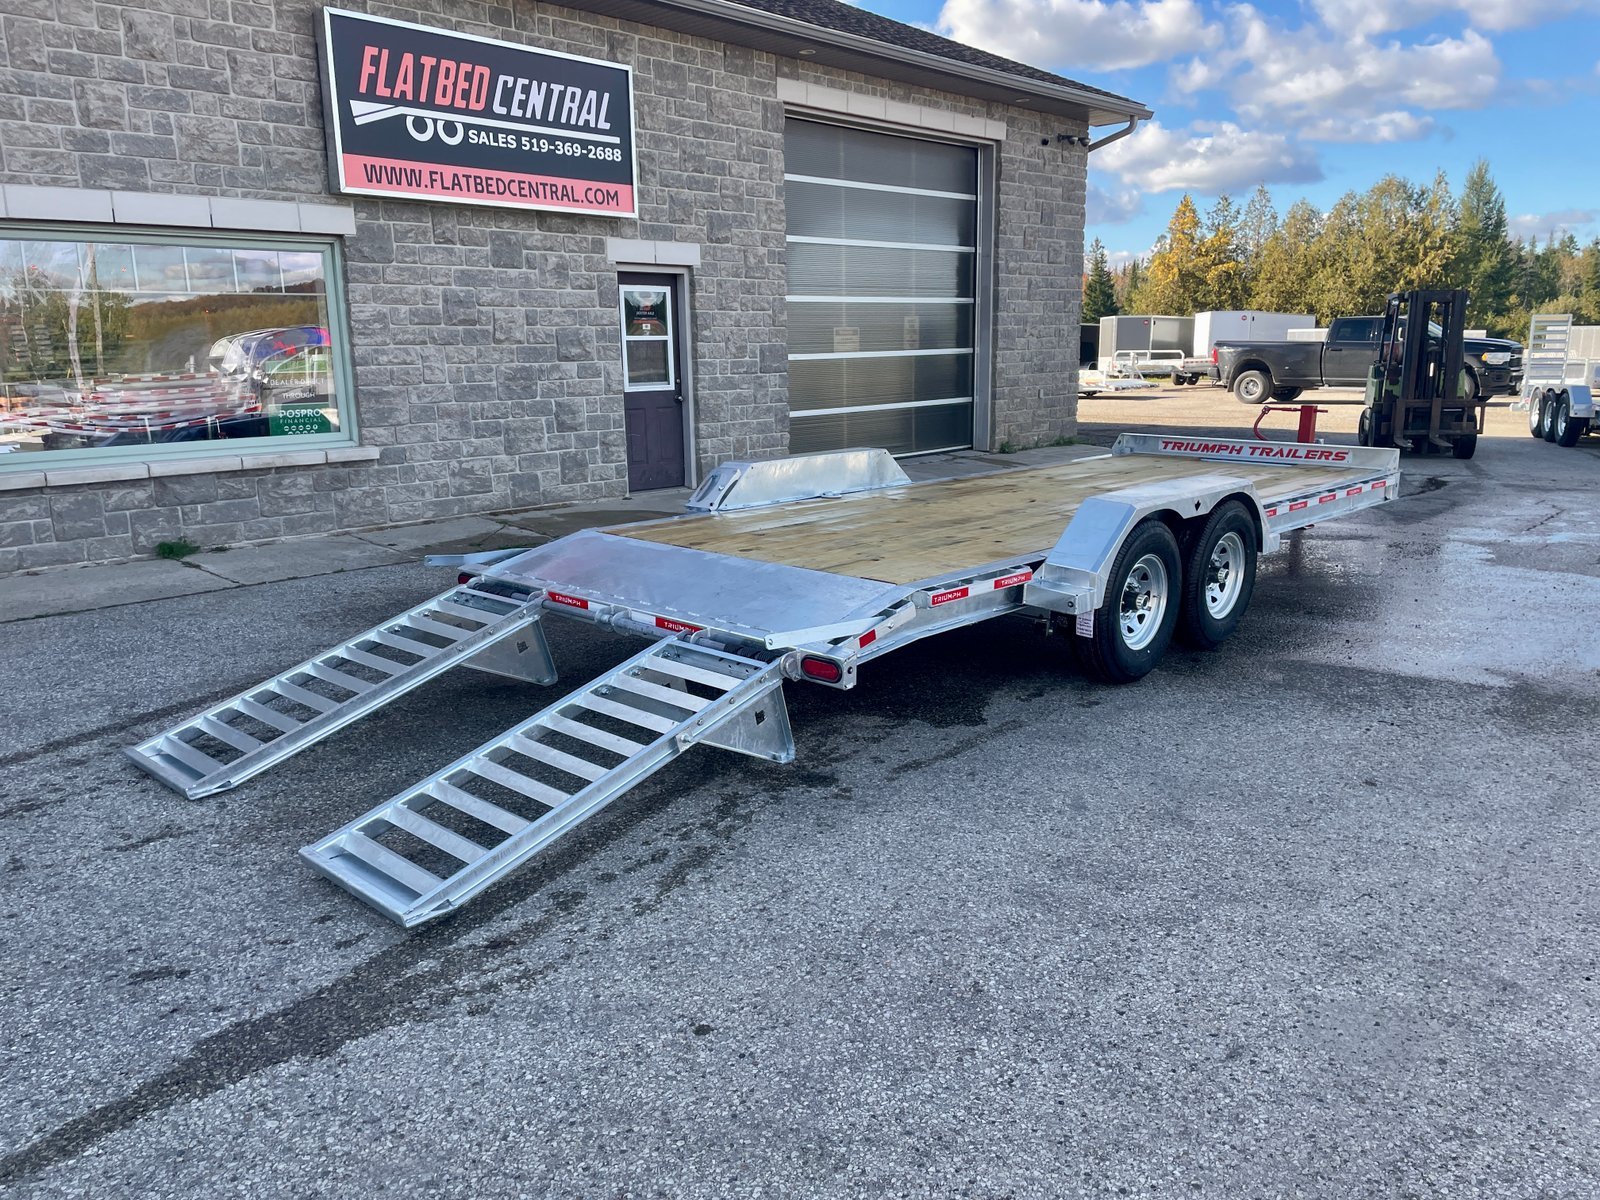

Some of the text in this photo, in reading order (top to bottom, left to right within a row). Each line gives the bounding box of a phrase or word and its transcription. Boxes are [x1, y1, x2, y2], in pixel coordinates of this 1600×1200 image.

[359, 45, 611, 130] FLATBED CENTRAL
[468, 129, 622, 162] SALES 519-369-2688
[363, 163, 619, 206] WWW.FLATBEDCENTRAL.COM
[1162, 440, 1350, 462] TRIUMPH TRAILERS
[1001, 575, 1026, 587] TRIUMPH
[555, 595, 581, 606] TRIUMPH
[933, 591, 962, 603] TRIUMPH
